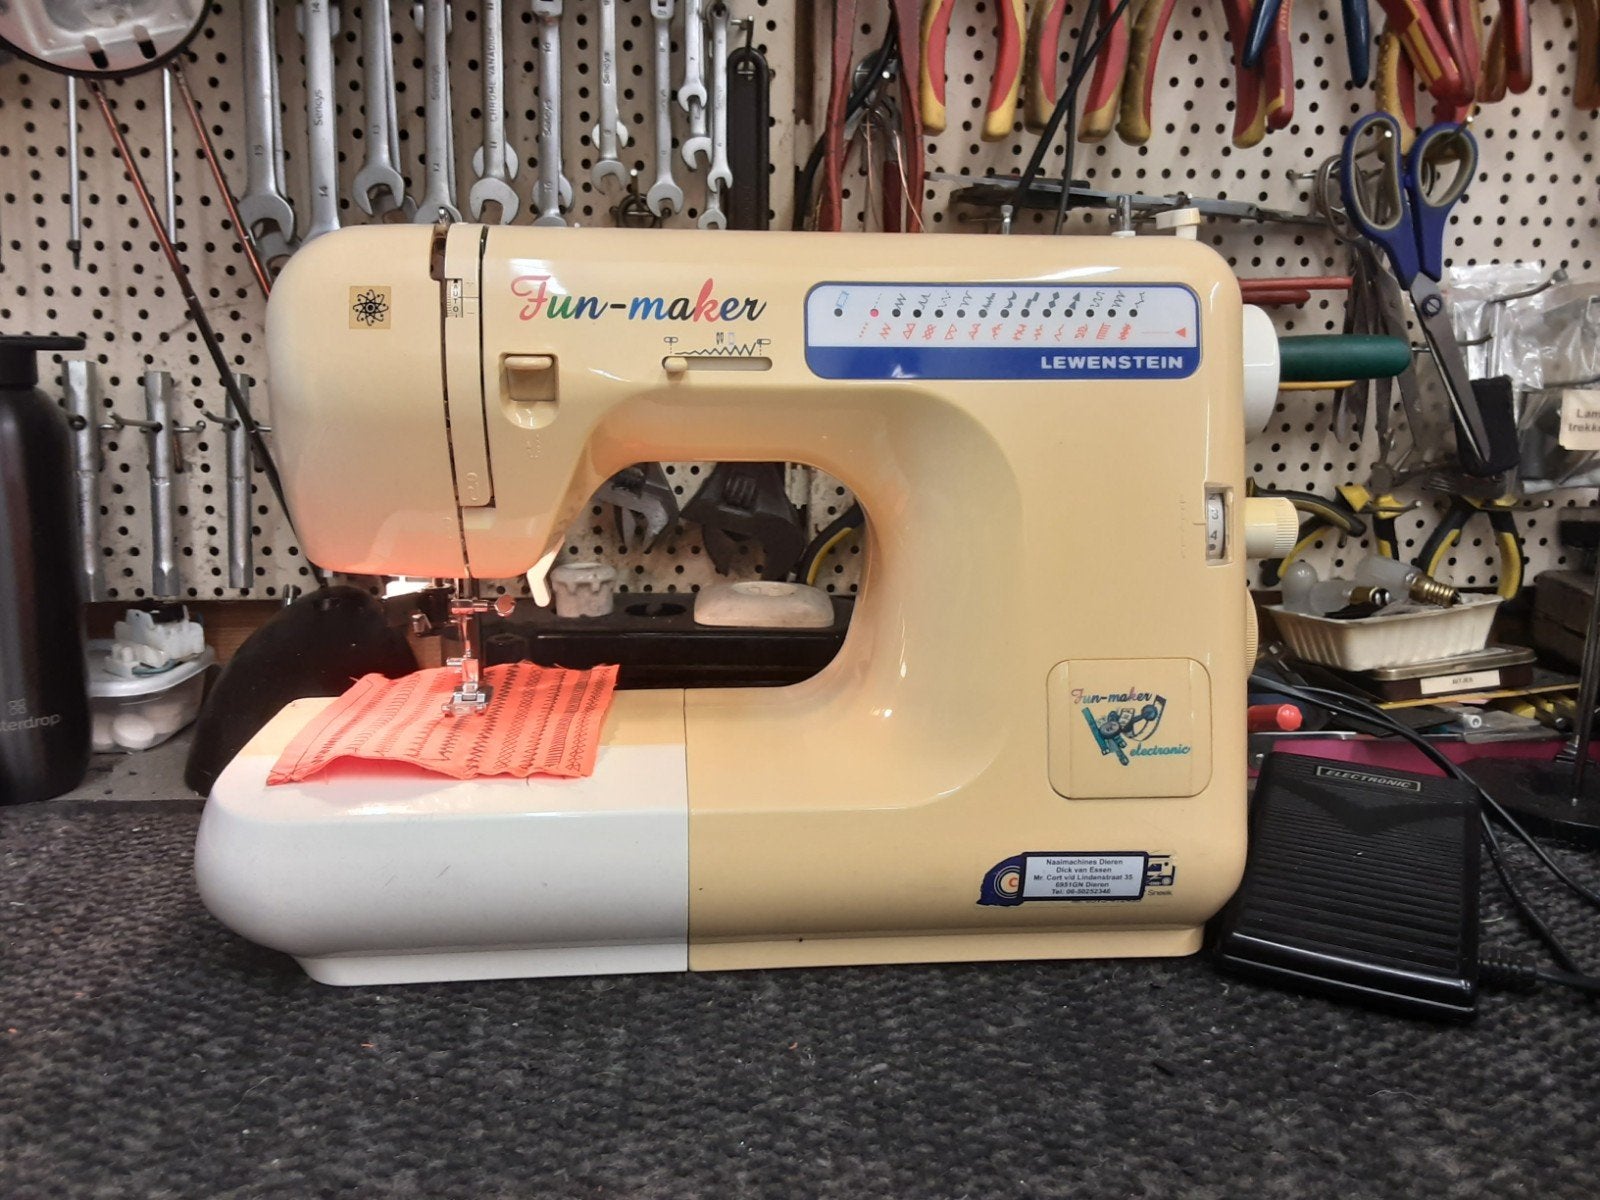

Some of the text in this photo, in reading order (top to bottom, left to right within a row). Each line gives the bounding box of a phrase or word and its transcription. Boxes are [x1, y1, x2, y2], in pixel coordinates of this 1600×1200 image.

[314, 89, 325, 127] Sencys
[452, 284, 460, 313] AUTO
[510, 274, 768, 323] Fun-maker
[1040, 354, 1184, 370] LEWENSTEIN
[1568, 422, 1600, 432] trekk
[1209, 529, 1219, 541] 4
[1071, 687, 1152, 704] Fun-maker
[0, 714, 61, 731] terdrop
[1130, 743, 1191, 757] electronic
[1325, 769, 1412, 789] ELECTRONIC
[1046, 858, 1097, 866] Naaimachines
